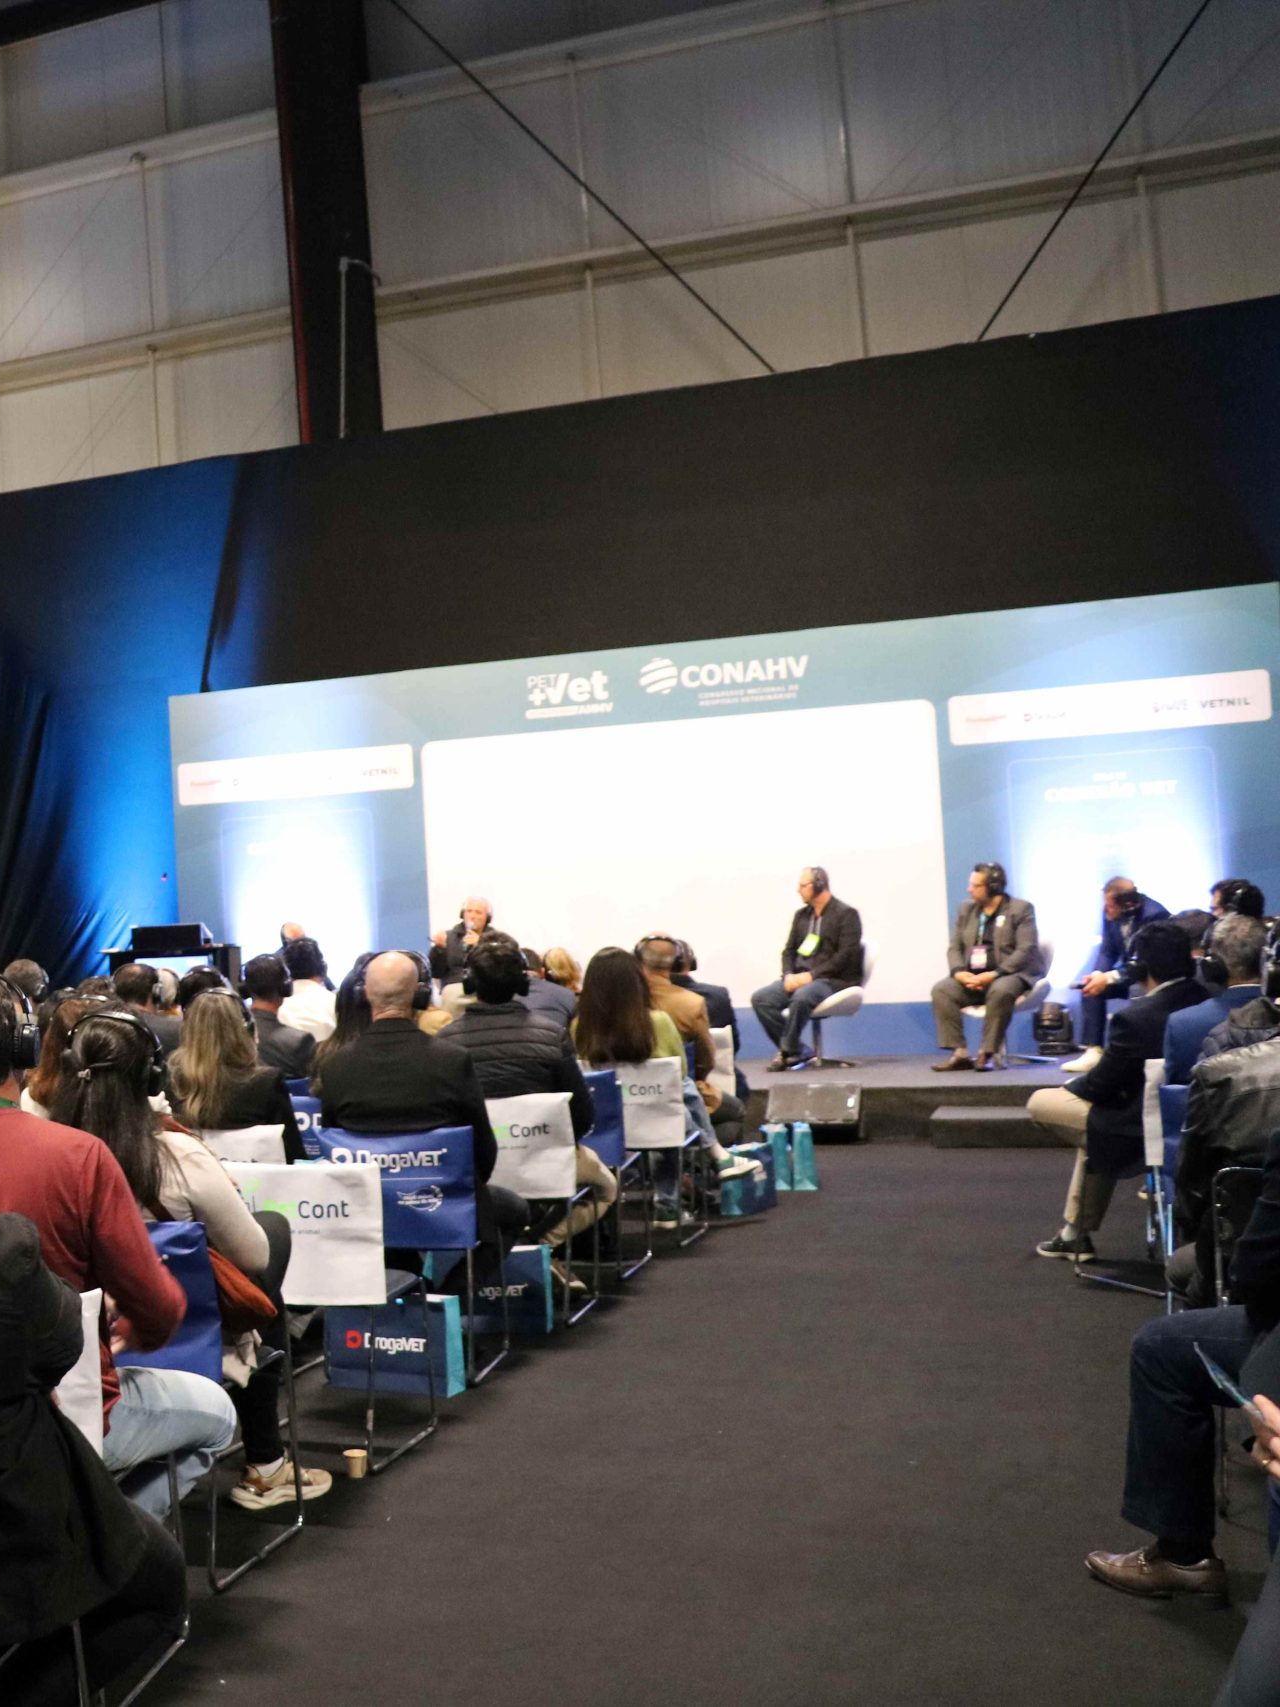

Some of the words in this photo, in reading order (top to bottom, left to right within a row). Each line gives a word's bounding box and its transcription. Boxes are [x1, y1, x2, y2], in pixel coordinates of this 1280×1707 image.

[680, 655, 809, 688] CONAHV
[527, 674, 557, 689] PET
[1200, 697, 1251, 709] VETNIL
[508, 1122, 551, 1138] Cont
